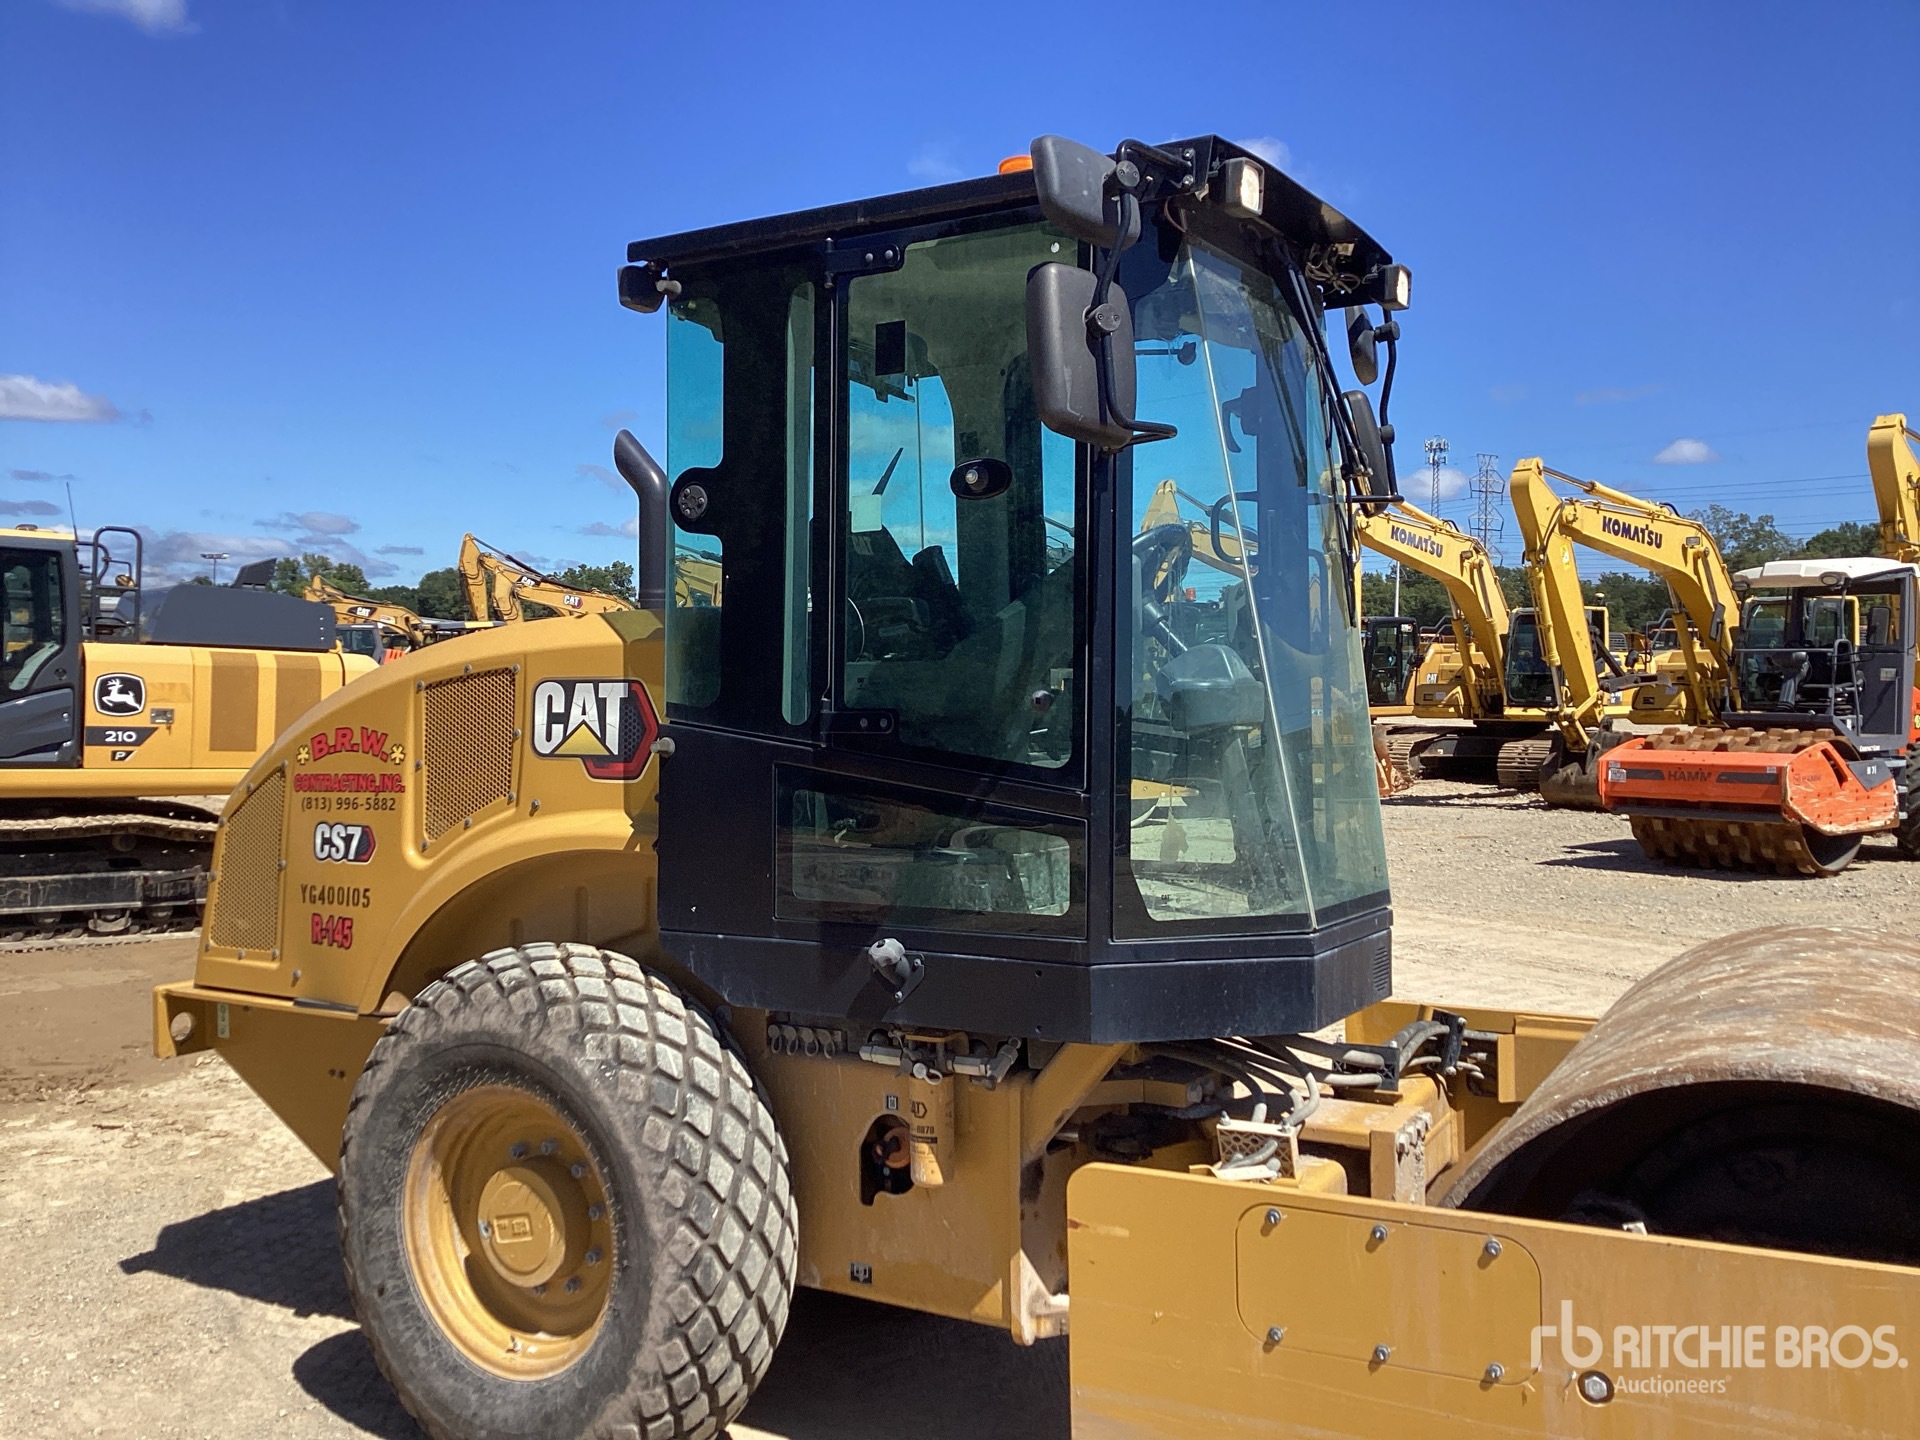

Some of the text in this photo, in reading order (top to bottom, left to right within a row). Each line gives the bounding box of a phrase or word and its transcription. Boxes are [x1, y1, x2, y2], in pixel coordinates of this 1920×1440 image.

[1391, 525, 1443, 558] KOMATSU
[1602, 515, 1663, 549] KOMATSU
[356, 606, 371, 617] CAT
[564, 595, 580, 606] CAT
[534, 682, 629, 755] CAT
[105, 731, 137, 742] 210
[310, 726, 389, 763] B.R.W.
[115, 751, 126, 761] P
[1668, 770, 1712, 782] HAMM
[301, 797, 396, 812] (813) 996-5882
[314, 823, 362, 861] CS7
[311, 912, 354, 951] R-145
